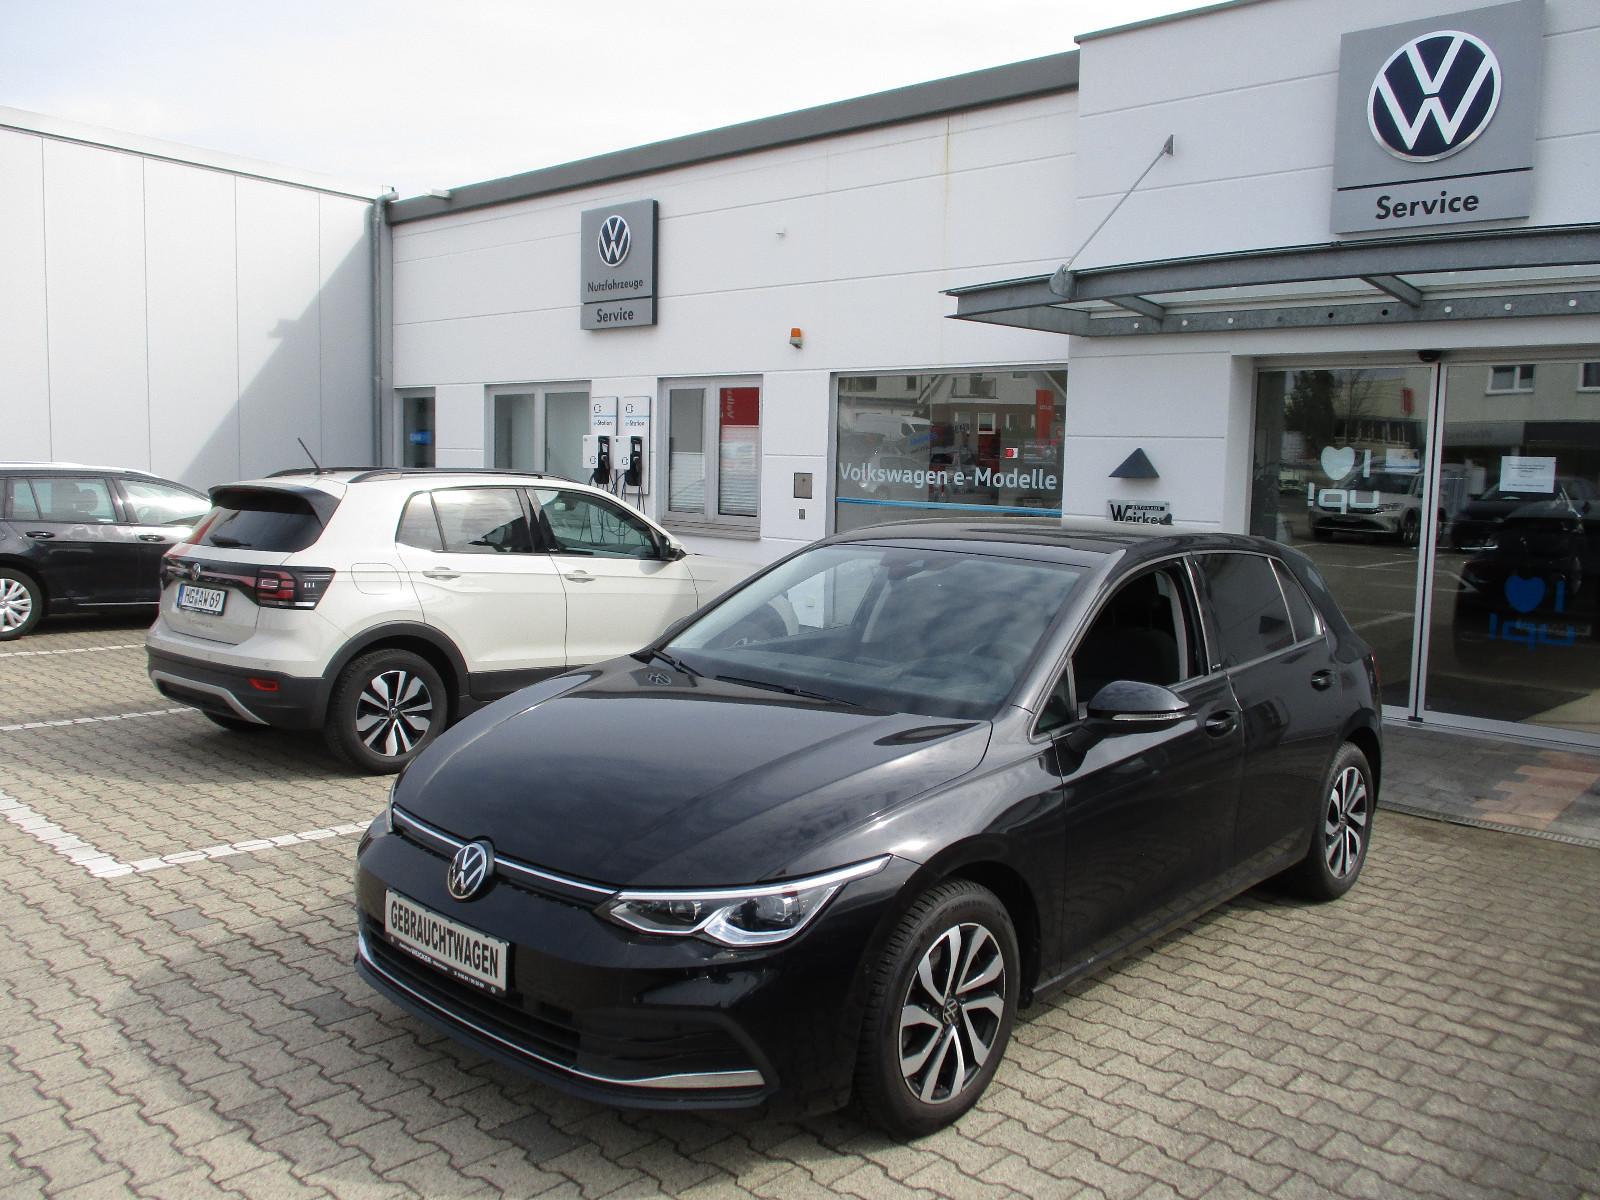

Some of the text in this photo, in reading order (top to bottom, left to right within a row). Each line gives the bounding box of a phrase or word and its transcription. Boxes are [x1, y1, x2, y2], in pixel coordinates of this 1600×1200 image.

[1375, 191, 1479, 220] Service
[587, 279, 644, 293] Nutzfahrzeuge
[596, 307, 634, 323] Service
[839, 462, 1058, 490] Volkswagen e-Modelle
[210, 592, 221, 609] 69
[391, 900, 499, 979] GEBRAUCHTWAGEN
